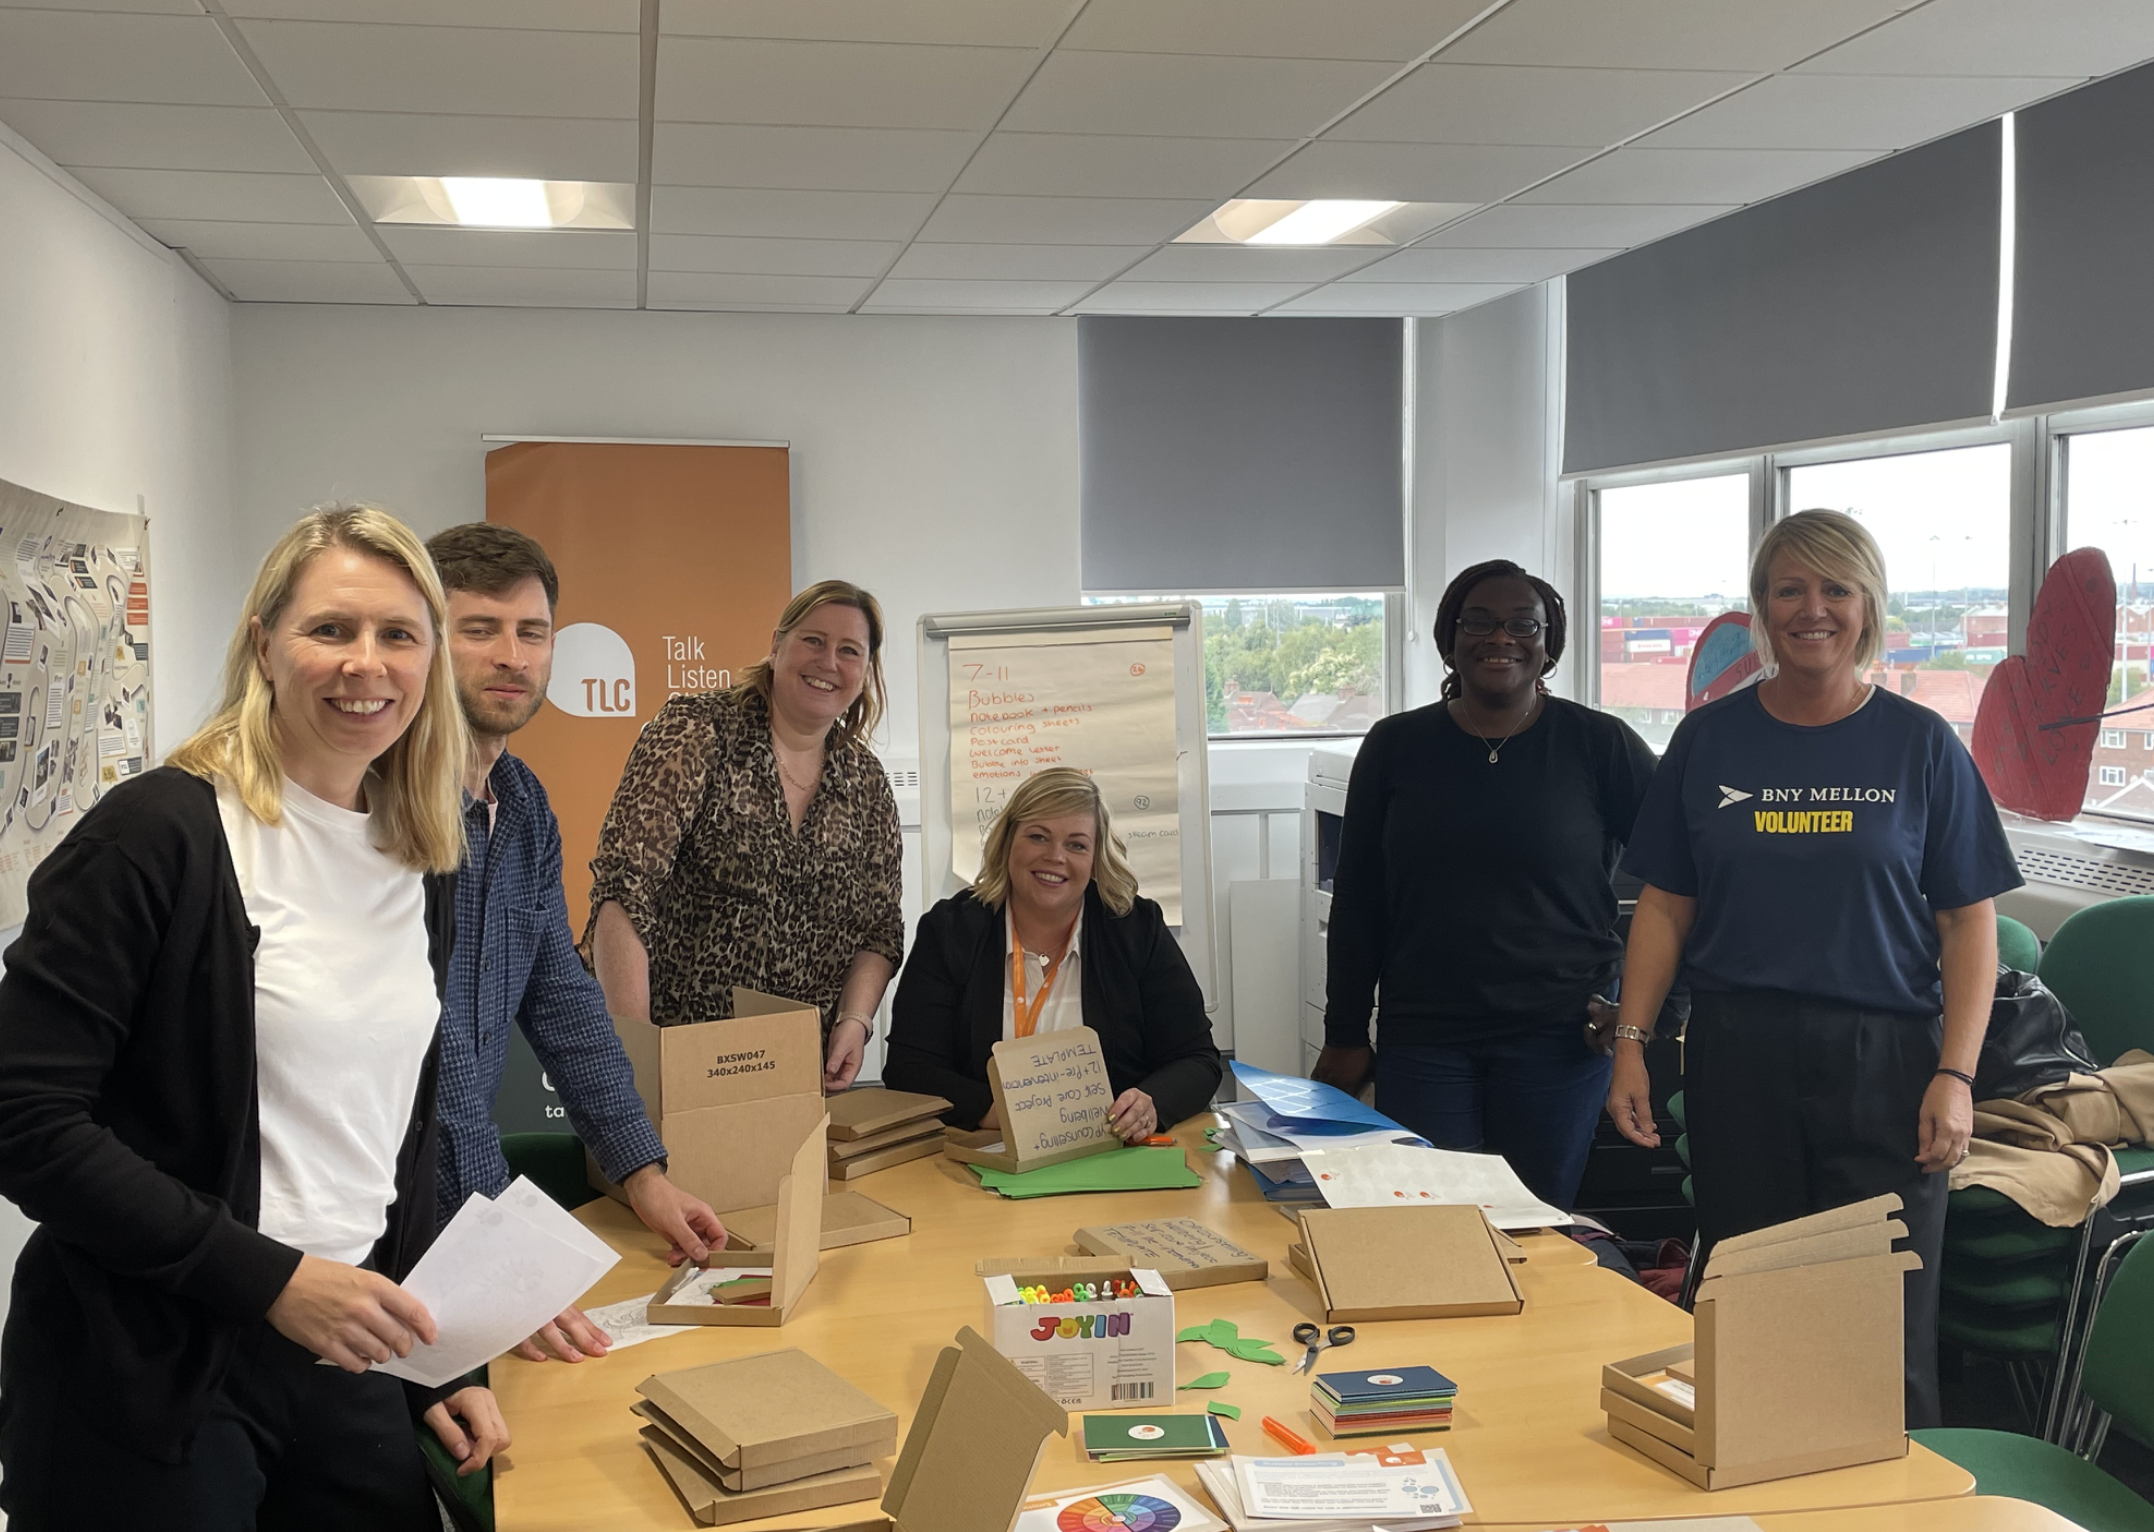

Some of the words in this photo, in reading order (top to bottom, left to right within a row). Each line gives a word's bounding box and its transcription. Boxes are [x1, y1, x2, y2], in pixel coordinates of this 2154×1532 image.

[662, 636, 705, 661] Talk
[667, 665, 730, 689] Listen
[581, 678, 631, 712] TLC
[968, 690, 1035, 710] Bubbles
[1053, 703, 1093, 714] pencils
[1042, 718, 1080, 728] sheets
[972, 770, 1021, 779] emotions
[1761, 788, 1803, 801] BNY
[1809, 787, 1896, 803] MELLON
[1754, 810, 1853, 833] VOLUNTEER
[717, 1050, 765, 1064] BXSW047
[1030, 1044, 1097, 1067] TEMPLATE
[707, 1061, 776, 1078] 340x240x145
[1015, 1093, 1053, 1112] Project
[1056, 1089, 1082, 1102] Care
[1029, 1312, 1131, 1342] JOYIN
